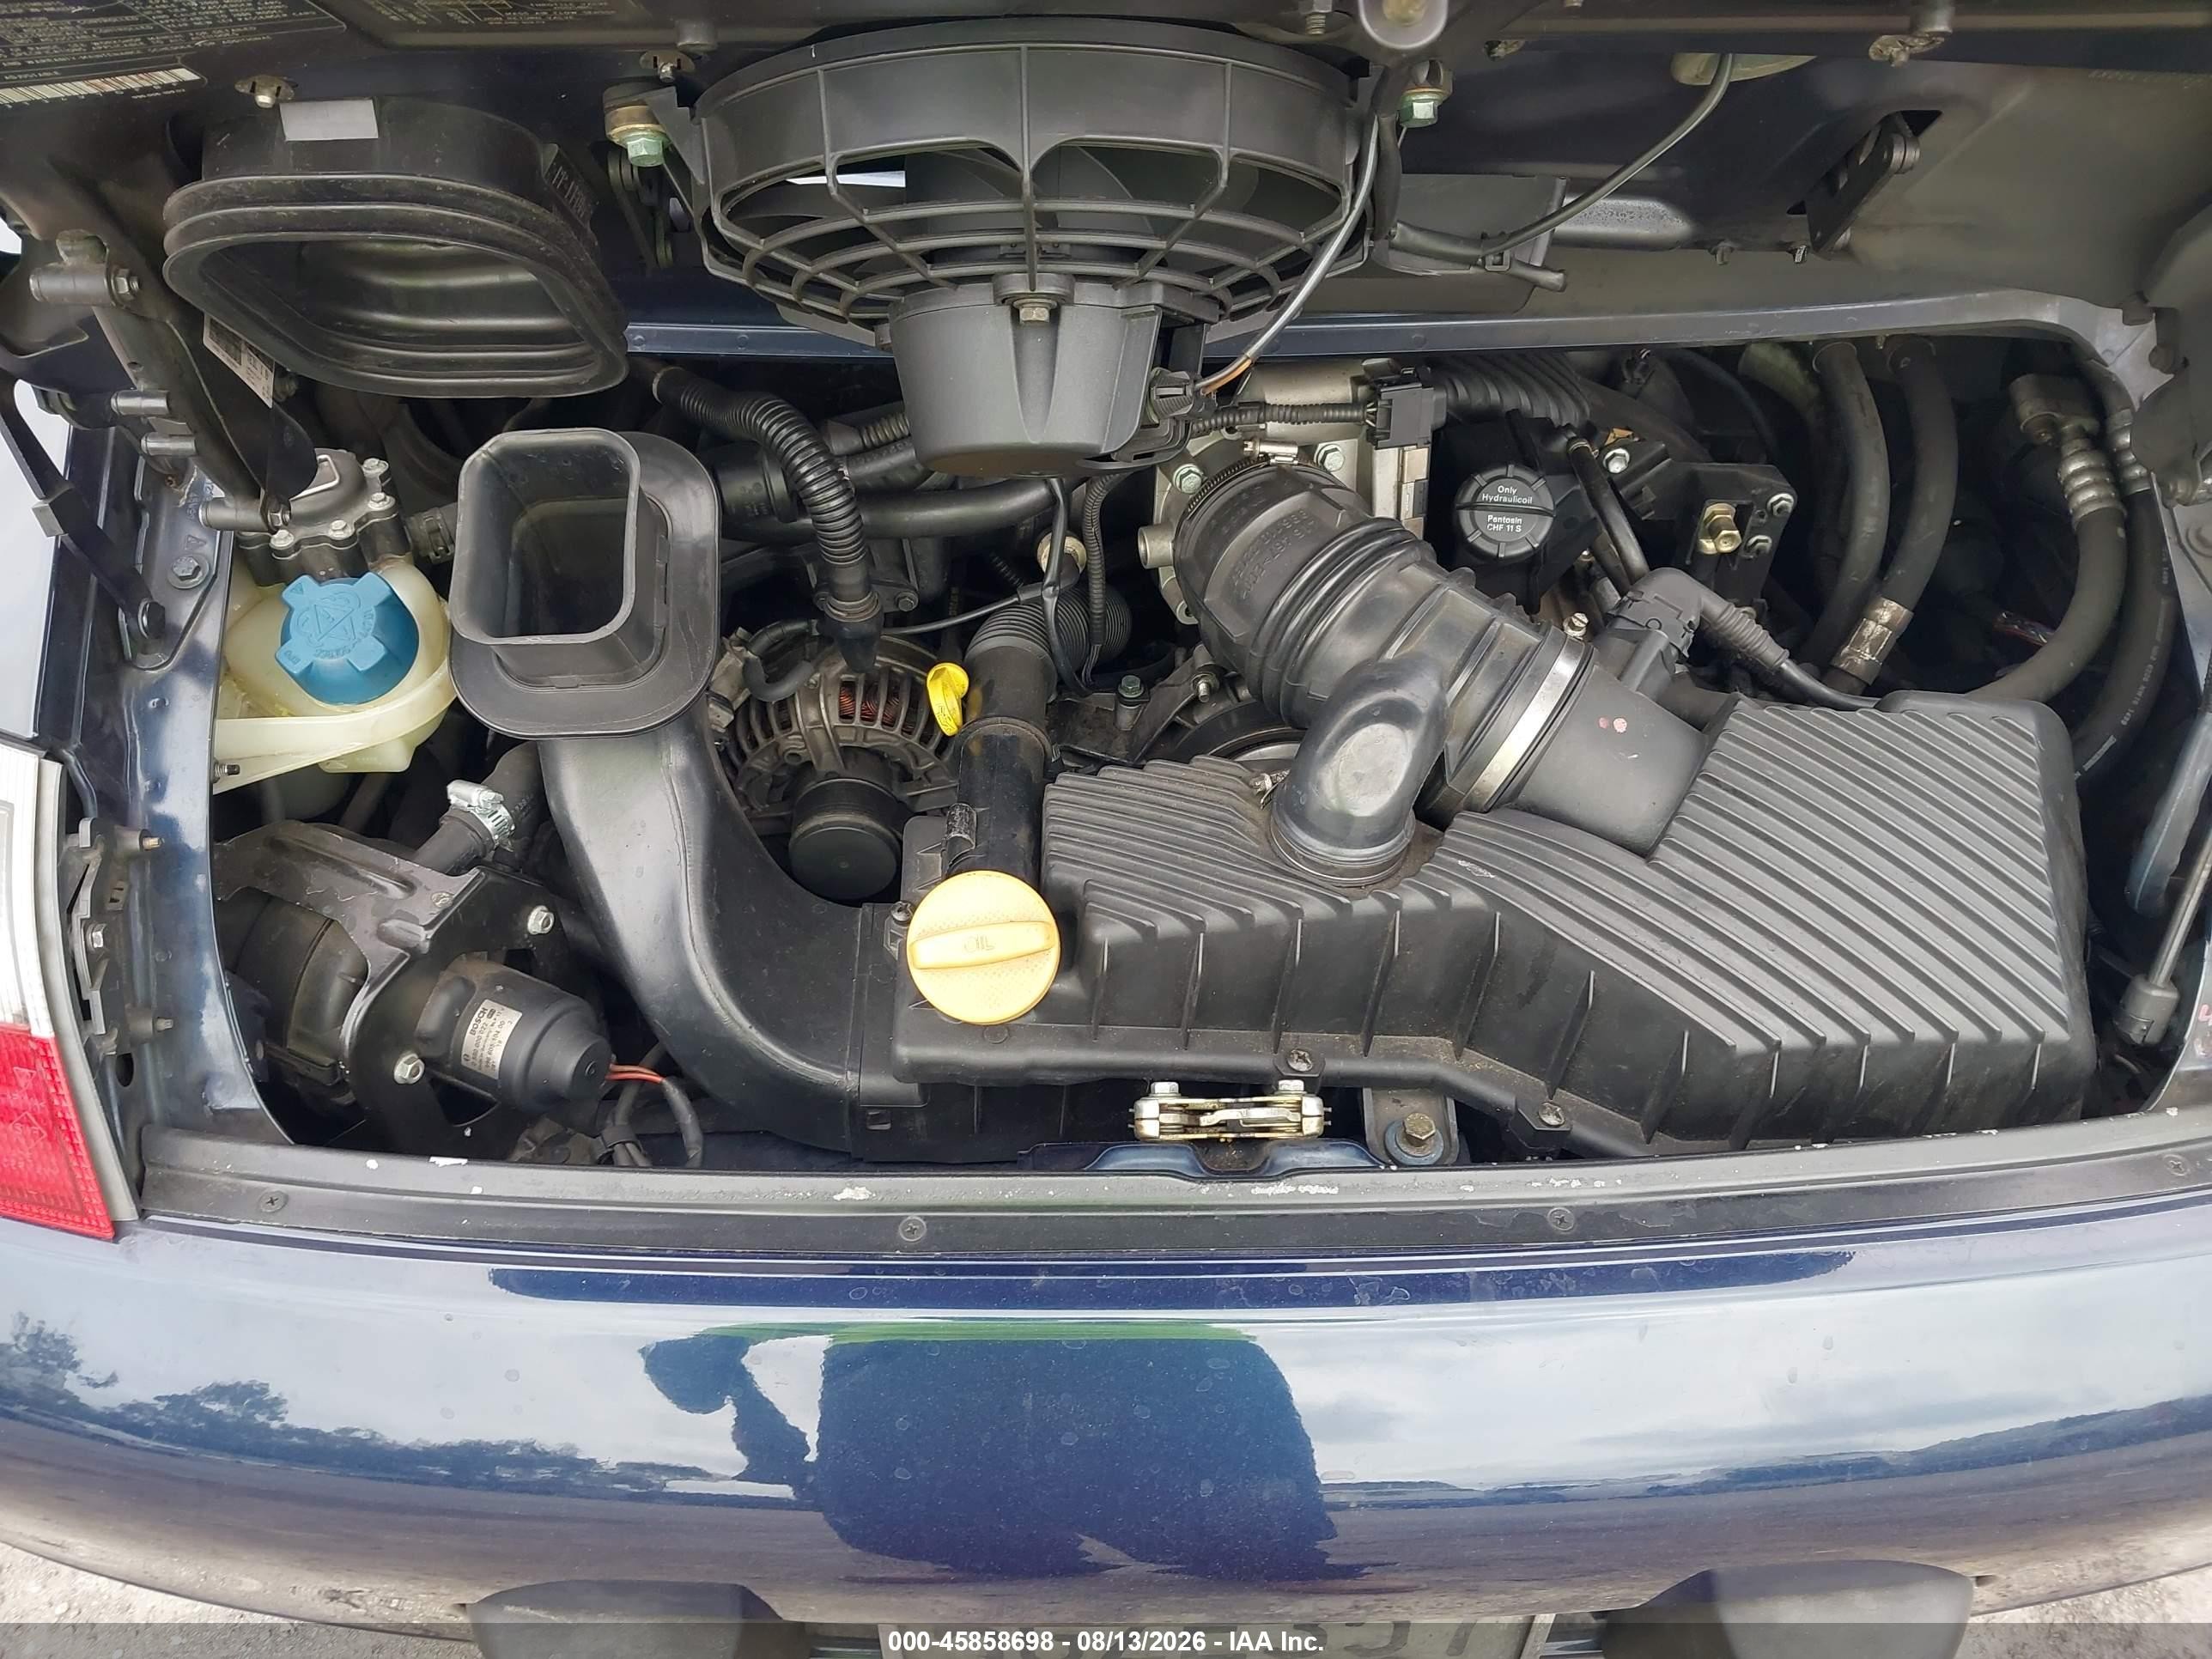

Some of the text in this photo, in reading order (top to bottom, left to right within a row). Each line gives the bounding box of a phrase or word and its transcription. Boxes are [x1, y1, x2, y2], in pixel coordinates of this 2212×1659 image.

[1498, 485, 1517, 495] Only
[1482, 494, 1533, 504] Hydraulicoil
[963, 934, 996, 953] OIL
[470, 1007, 489, 1036] BOSCH
